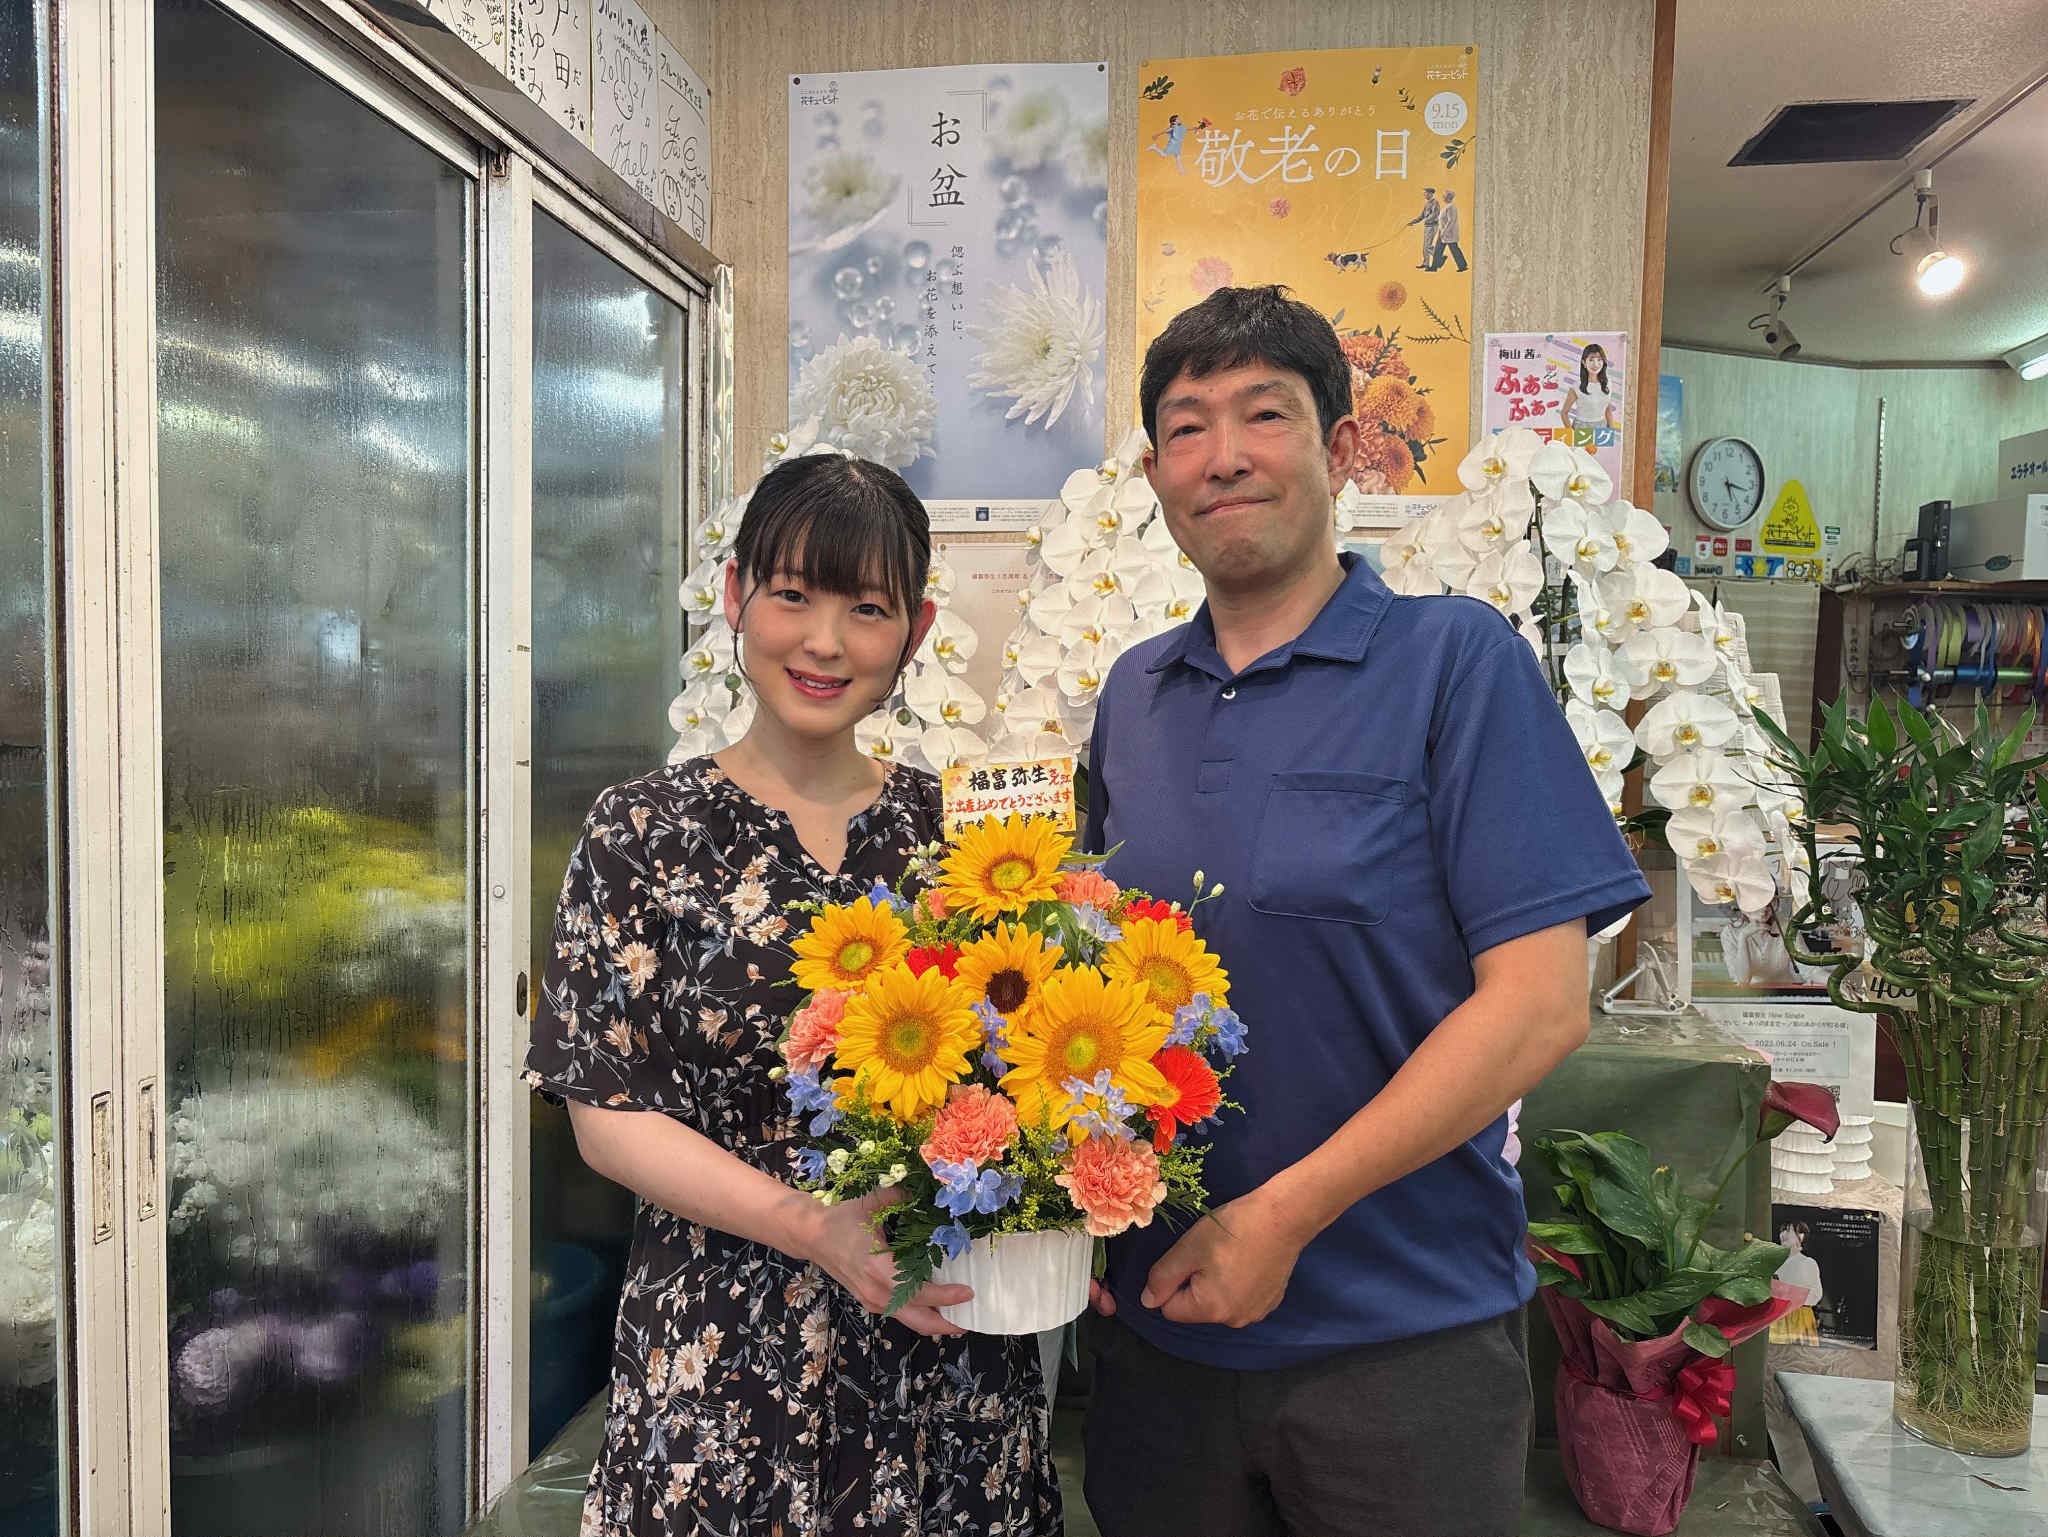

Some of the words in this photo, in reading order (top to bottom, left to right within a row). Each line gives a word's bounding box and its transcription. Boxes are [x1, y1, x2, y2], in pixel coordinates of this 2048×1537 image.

[1431, 103, 1460, 119] 9.15
[1194, 124, 1411, 188] 敬老の日
